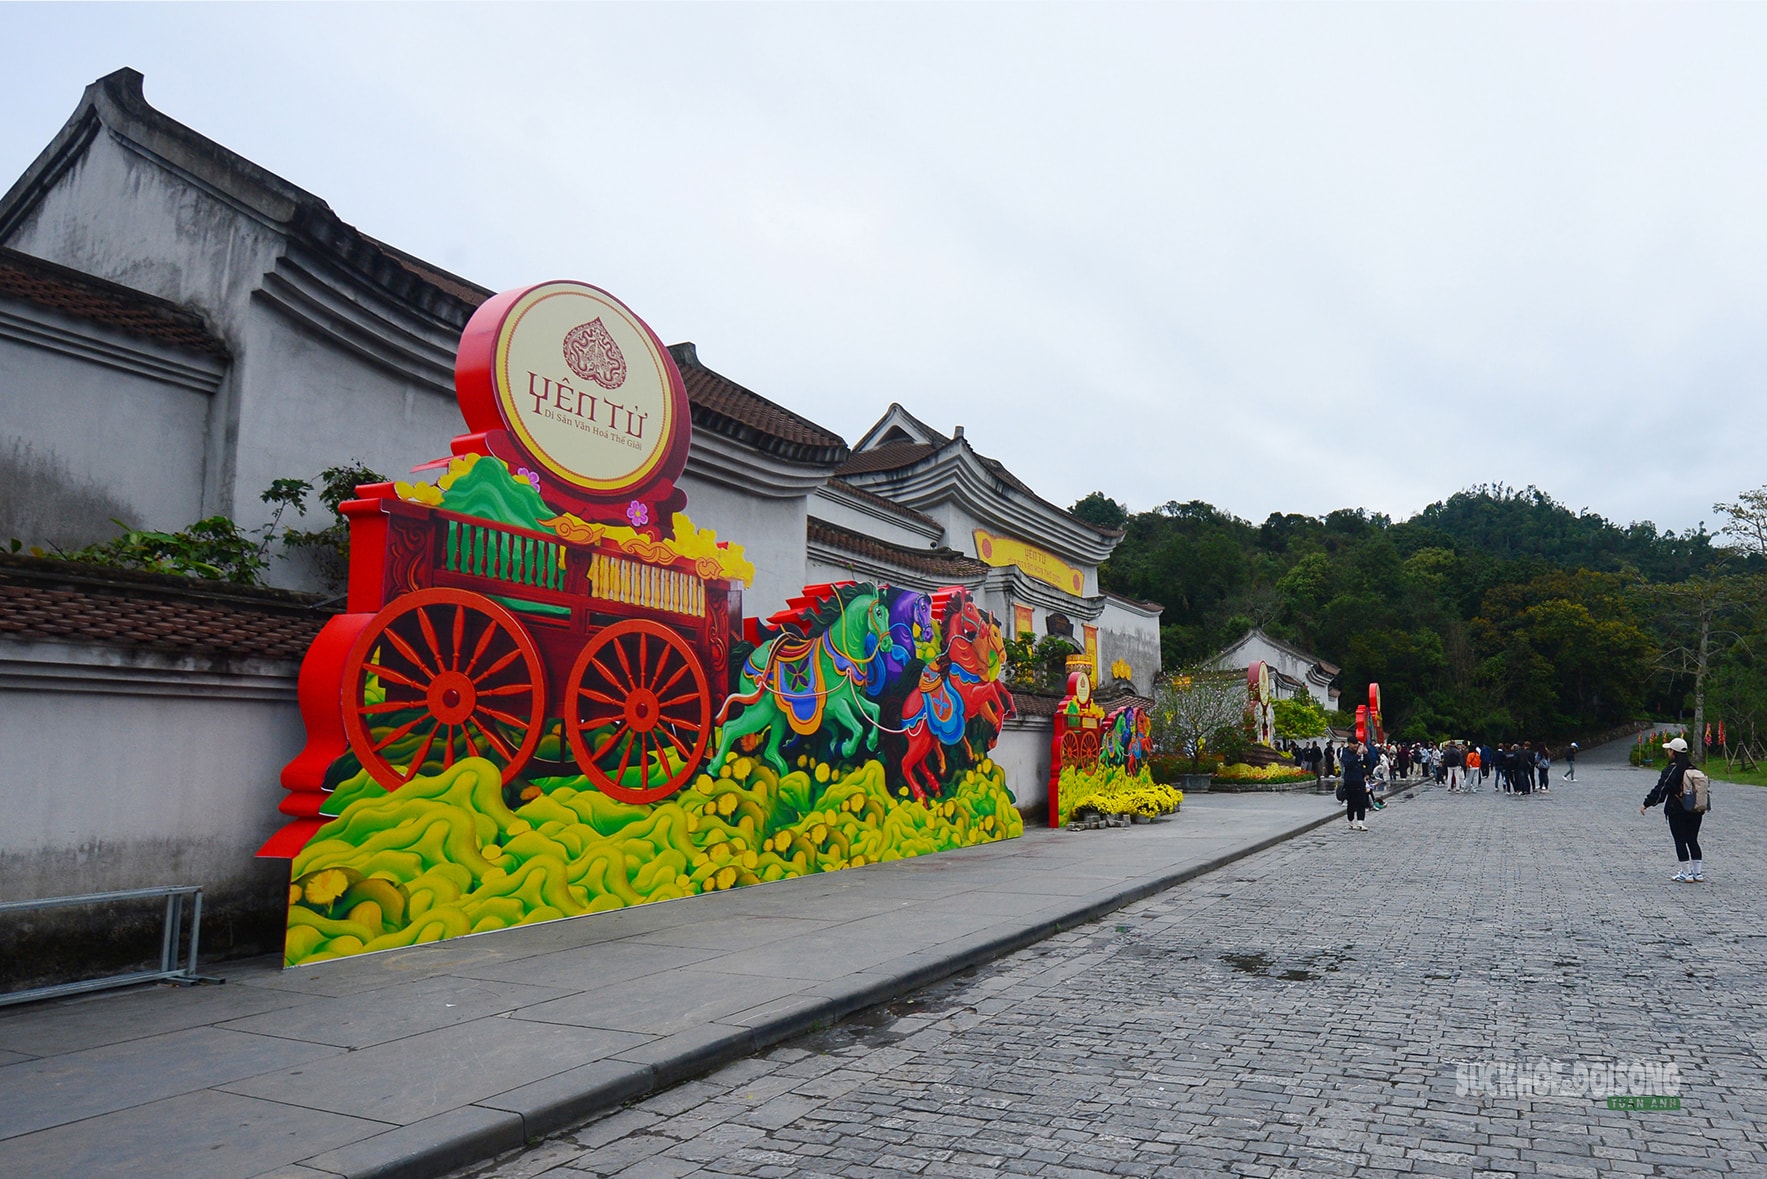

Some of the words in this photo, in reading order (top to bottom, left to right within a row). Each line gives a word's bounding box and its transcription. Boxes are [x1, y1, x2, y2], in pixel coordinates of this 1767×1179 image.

[527, 371, 598, 422] YÊN
[603, 397, 649, 439] TỬ
[574, 419, 591, 432] Văn
